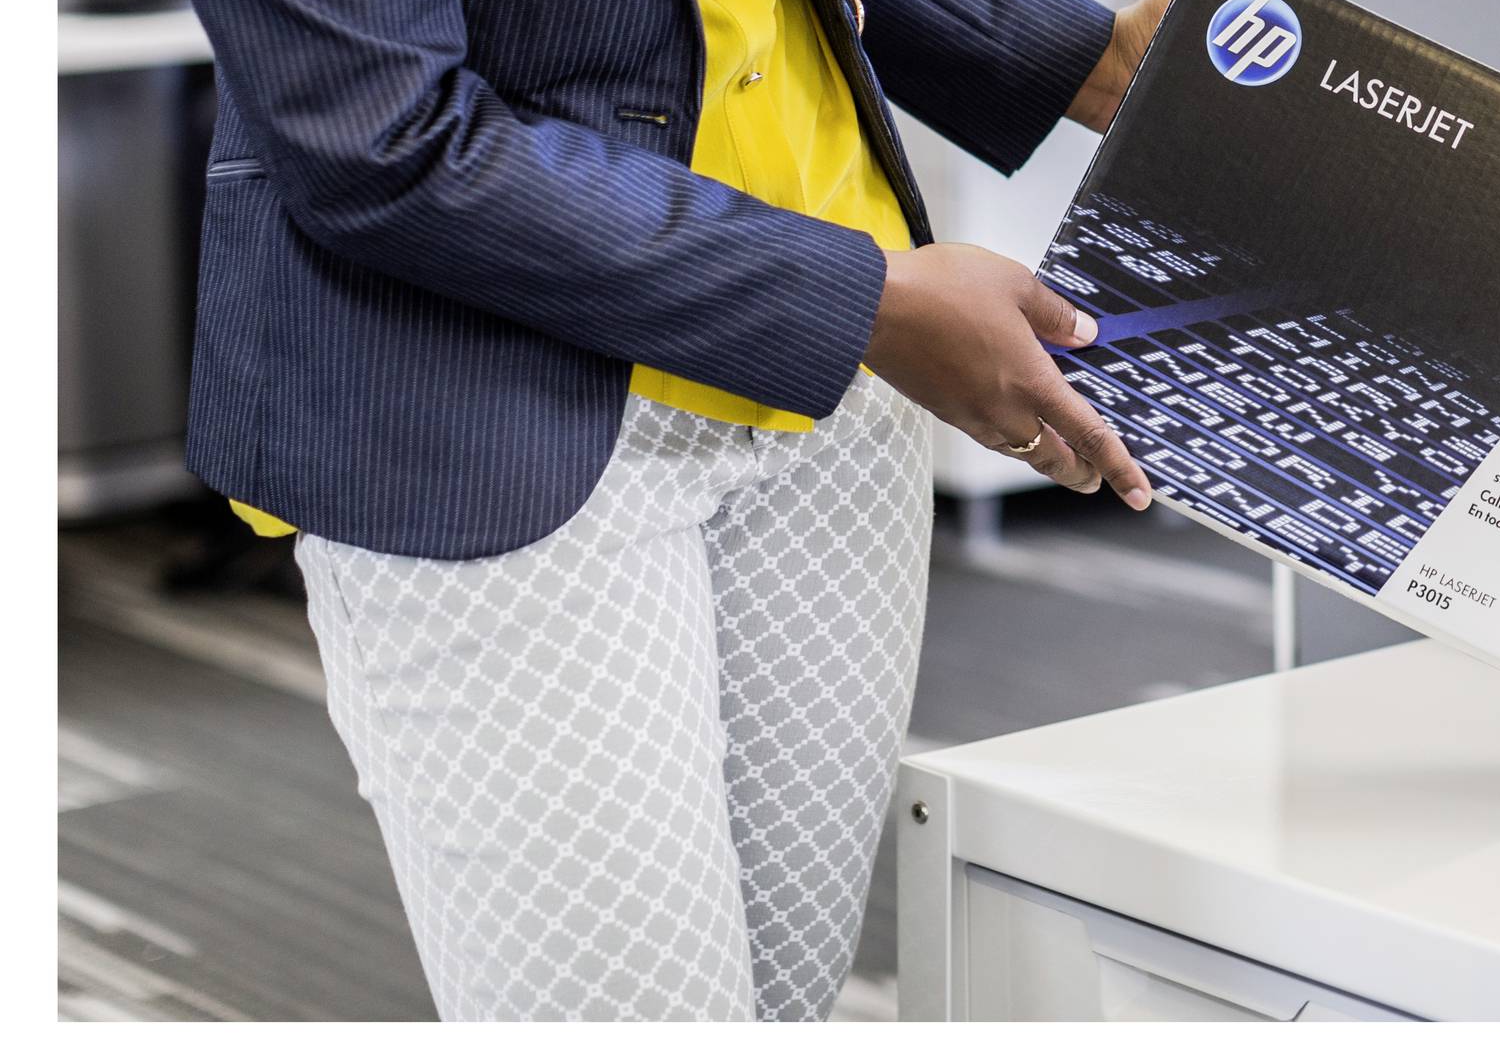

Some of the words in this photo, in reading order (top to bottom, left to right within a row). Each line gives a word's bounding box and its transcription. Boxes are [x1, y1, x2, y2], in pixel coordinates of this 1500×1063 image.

[1320, 59, 1474, 149] LASERJET
[1139, 350, 1316, 443] NEW
[1177, 345, 1398, 462] HONG
[1227, 333, 1469, 476] TOKYO
[1244, 326, 1490, 467] PARIS
[1058, 372, 1247, 470] RIO
[1298, 498, 1409, 564] DE
[1466, 502, 1483, 520] En
[1405, 578, 1453, 610] P3015
[1417, 561, 1439, 581] HP
[1437, 571, 1498, 610] LASERJET
